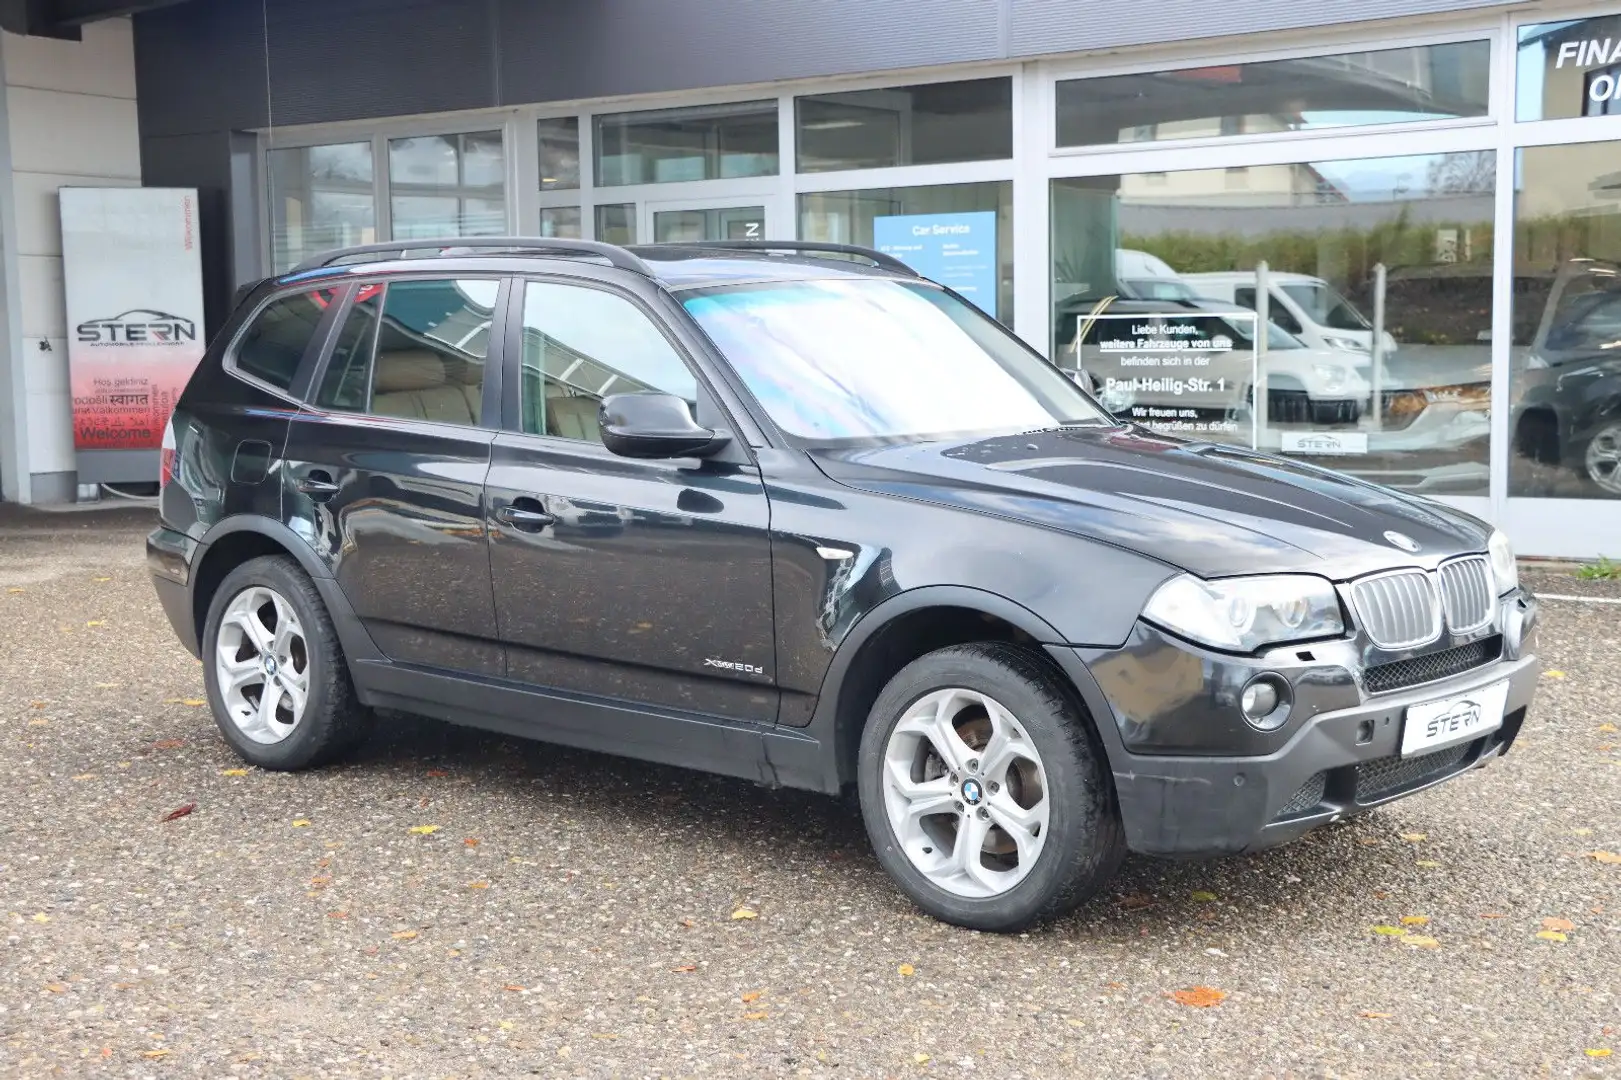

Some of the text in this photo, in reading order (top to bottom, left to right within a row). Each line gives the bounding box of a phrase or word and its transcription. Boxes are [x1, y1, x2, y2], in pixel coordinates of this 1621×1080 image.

[912, 224, 971, 236] Car Service
[77, 323, 196, 341] STERN
[1131, 324, 1199, 336] Liebe Kunden,
[1100, 338, 1232, 350] weitere Fahrzeuge von uns
[1121, 356, 1211, 367] befinden sich in der
[1106, 377, 1225, 395] Paul-Heilig-Str. 1
[109, 394, 148, 406] स्वागत
[1132, 407, 1198, 418] Wir freuen uns,
[1151, 420, 1194, 432] begrüßen
[1196, 422, 1207, 431] zu
[80, 427, 151, 440] Welcome
[1426, 710, 1481, 737] STERN
